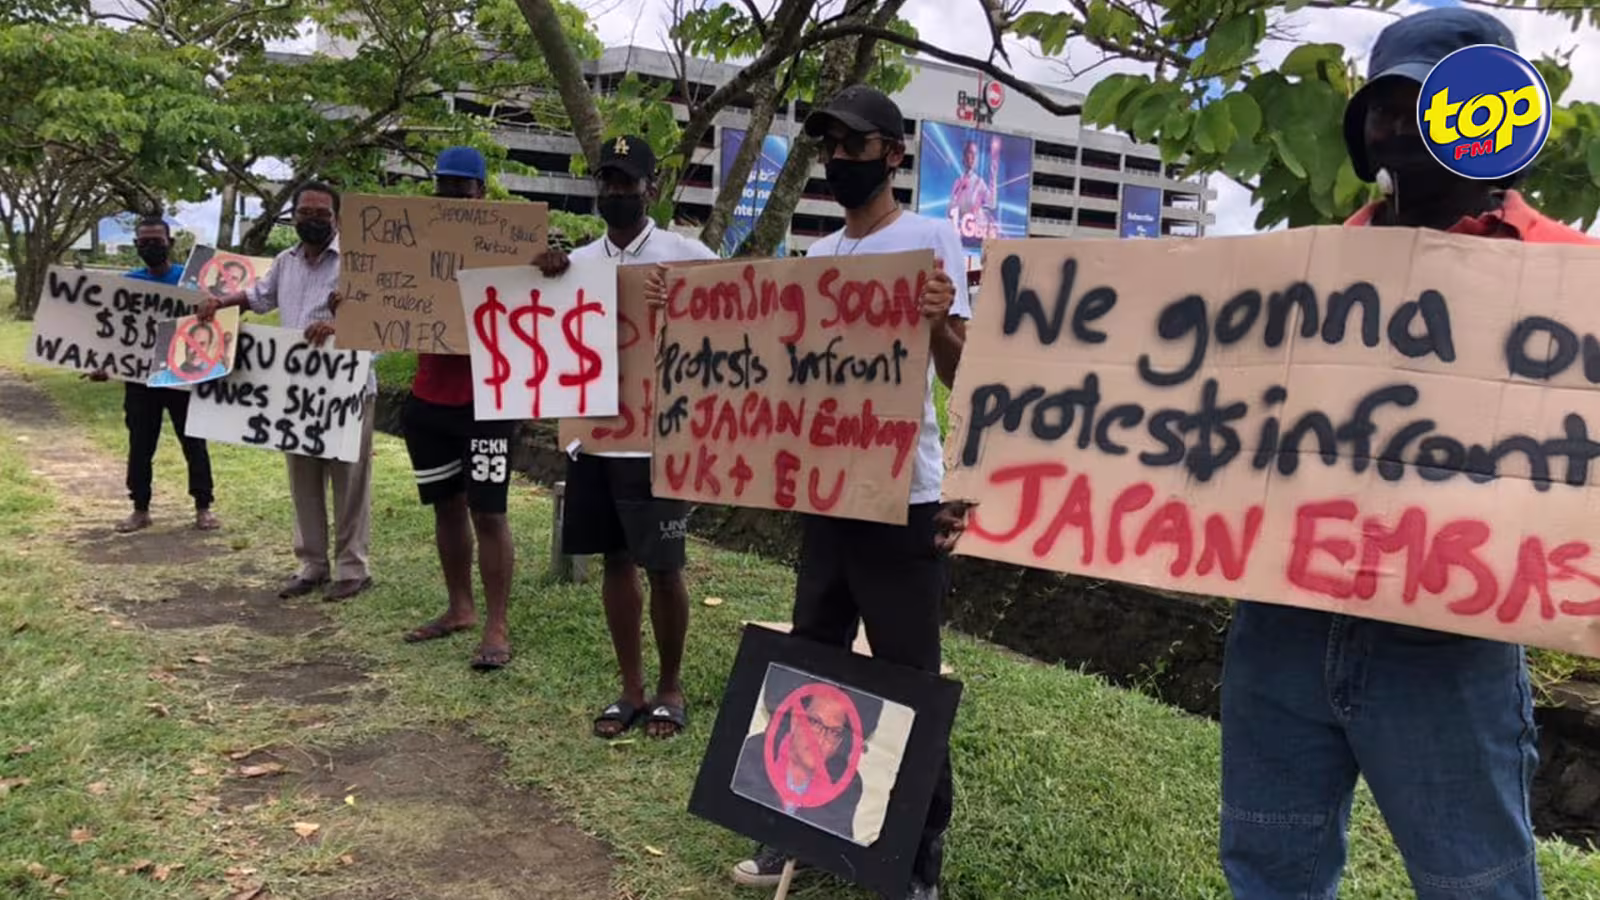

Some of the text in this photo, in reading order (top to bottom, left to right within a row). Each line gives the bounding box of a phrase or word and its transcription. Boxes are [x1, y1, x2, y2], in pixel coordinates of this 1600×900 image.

[49, 272, 201, 318] We DEMAN
[1001, 254, 1117, 345] We
[1137, 281, 1456, 386] gonna
[473, 286, 606, 418] $$$
[242, 411, 326, 456] $$$
[691, 391, 805, 442] JAPAN
[471, 454, 507, 483] 33
[773, 449, 847, 511] EU
[970, 461, 1265, 582] JAPAN
